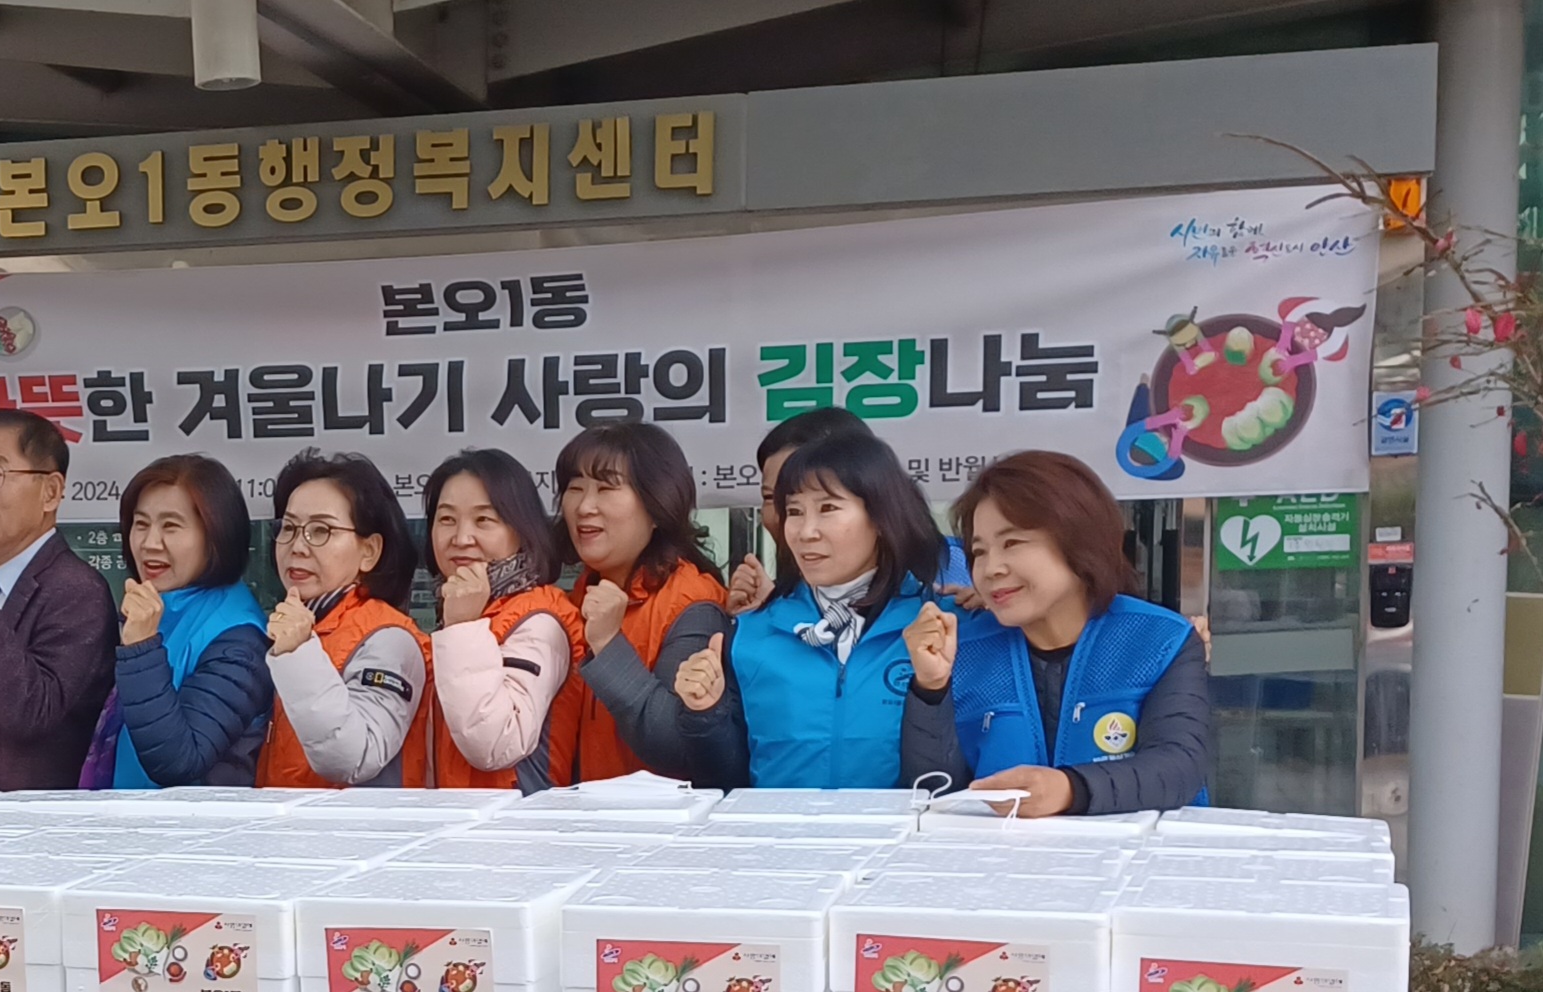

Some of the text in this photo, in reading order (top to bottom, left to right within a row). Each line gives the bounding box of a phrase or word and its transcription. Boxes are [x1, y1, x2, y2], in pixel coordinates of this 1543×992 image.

[381, 273, 589, 336] 본오1동
[177, 361, 464, 439] 겨울나기
[491, 347, 727, 429] 사랑의
[757, 332, 1099, 421] 김장나눔
[71, 481, 120, 501] 2024
[88, 530, 108, 545] 2층
